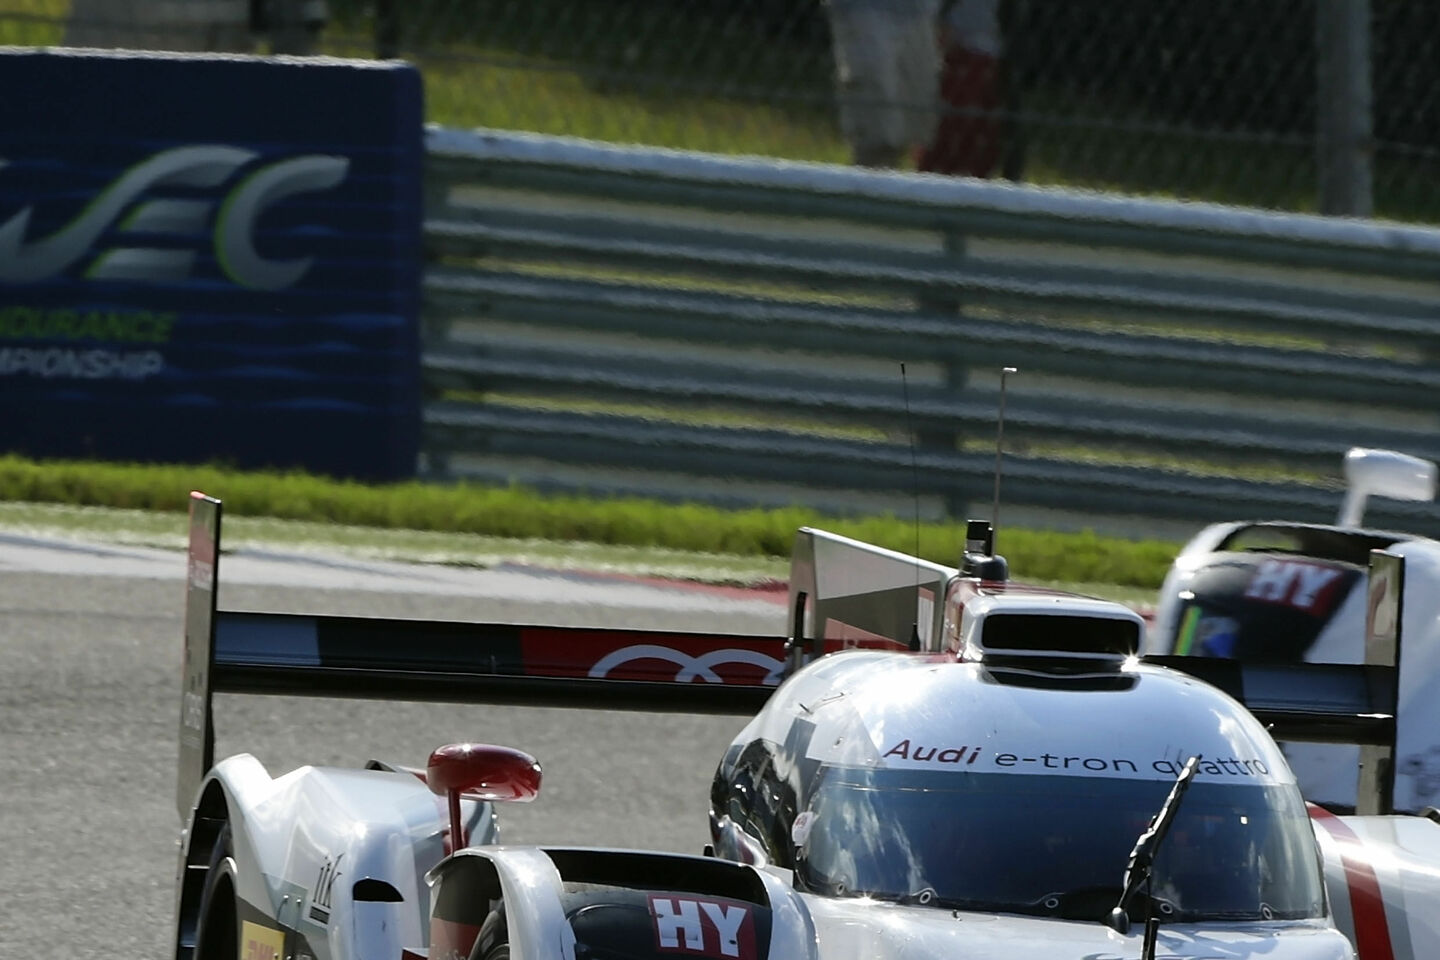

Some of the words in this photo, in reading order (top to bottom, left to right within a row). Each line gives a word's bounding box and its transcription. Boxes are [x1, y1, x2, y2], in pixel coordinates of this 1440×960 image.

[1248, 559, 1342, 608] HY
[882, 739, 983, 765] Audi
[995, 752, 1137, 773] e-tron
[651, 897, 750, 958] HY
